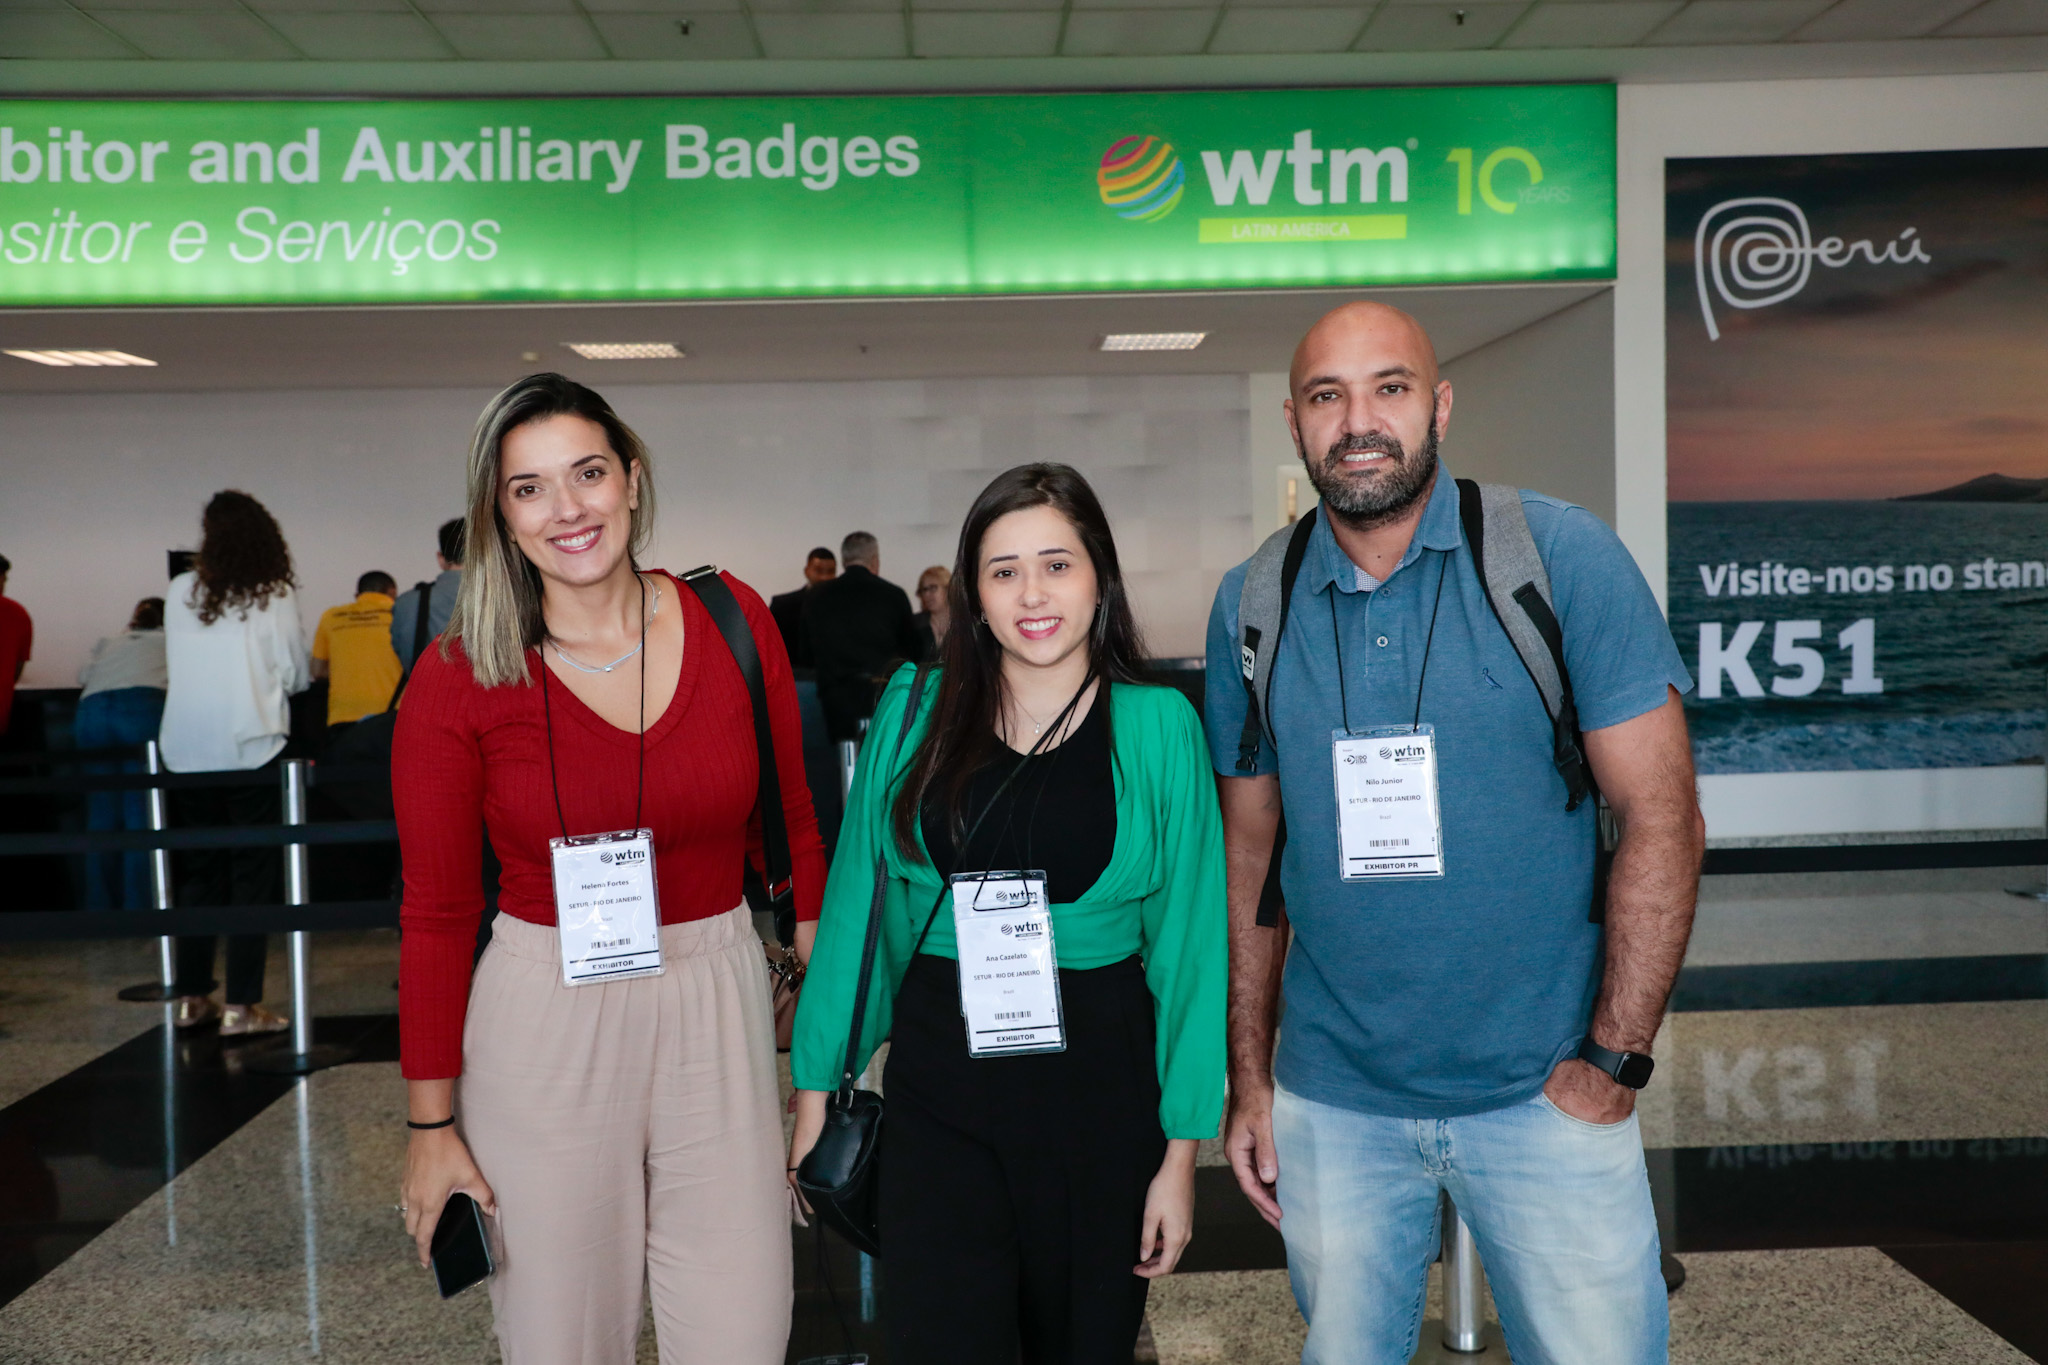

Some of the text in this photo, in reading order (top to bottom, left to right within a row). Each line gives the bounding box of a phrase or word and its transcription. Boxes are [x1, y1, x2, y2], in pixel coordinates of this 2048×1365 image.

[189, 128, 319, 183] and
[342, 127, 643, 193] Auxiliary
[666, 123, 920, 191] Badges
[1200, 129, 1408, 205] wtm
[1446, 146, 1543, 215] 10
[1232, 222, 1350, 239] LATIN AMERICA
[0, 206, 500, 275] sitor e Serviços
[1695, 197, 1931, 341] Perú
[1699, 557, 2048, 597] Visite-nos no stan
[1699, 618, 1884, 698] K51
[1394, 745, 1425, 757] wtm
[615, 849, 645, 860] wtm
[568, 901, 589, 910] SETUR
[615, 895, 642, 904] JANEIRO
[592, 959, 634, 971] EXHIBITOR
[999, 953, 1028, 961] Cazelato
[1016, 969, 1041, 977] JANEIRO
[996, 1033, 1035, 1043] EXHIBITOR
